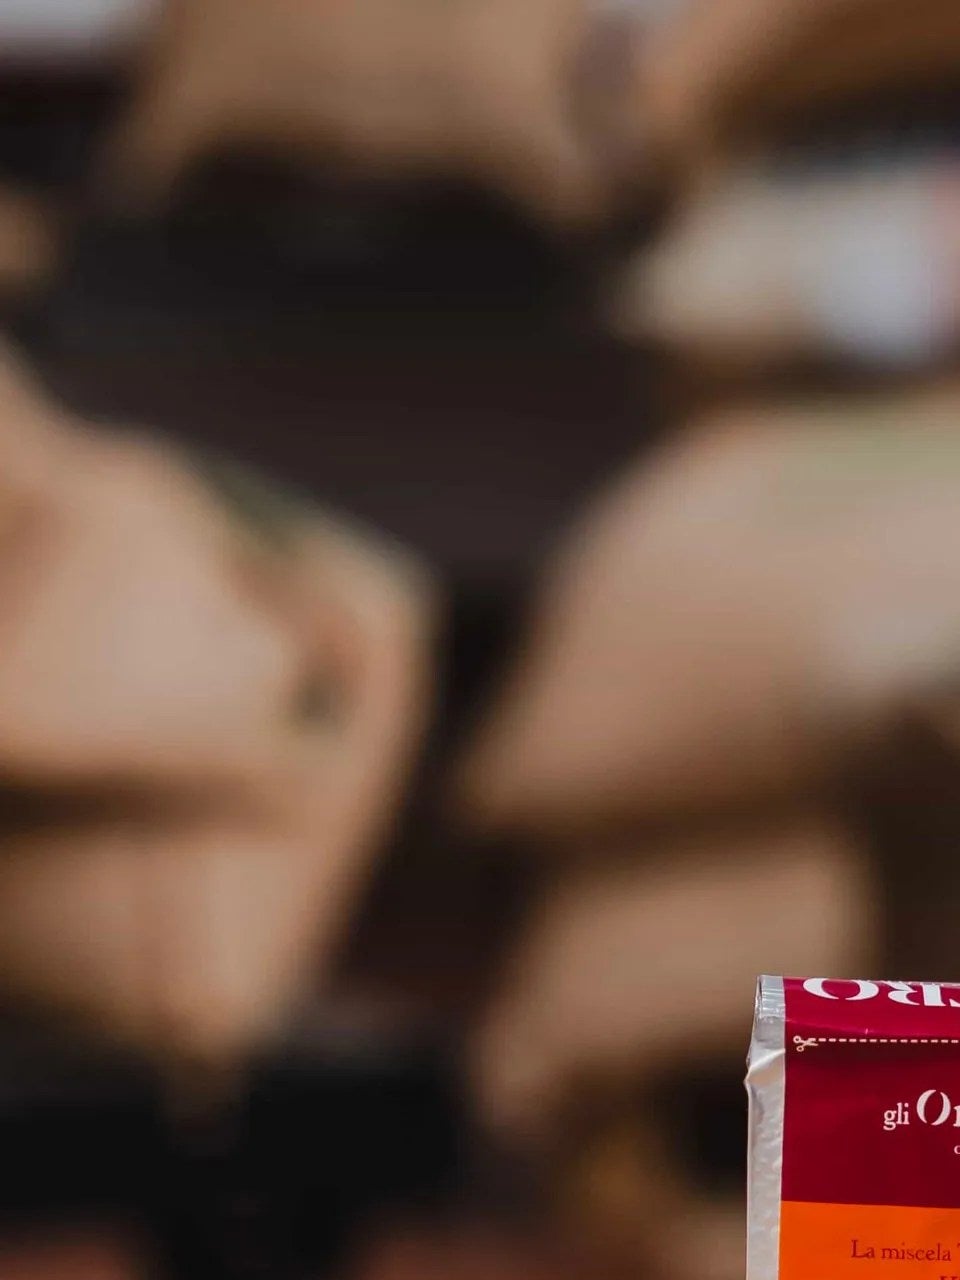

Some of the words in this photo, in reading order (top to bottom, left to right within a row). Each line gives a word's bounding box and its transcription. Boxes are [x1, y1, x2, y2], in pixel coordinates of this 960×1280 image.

[883, 1101, 910, 1130] gli
[851, 1240, 875, 1259] La
[881, 1242, 951, 1262] miscela
